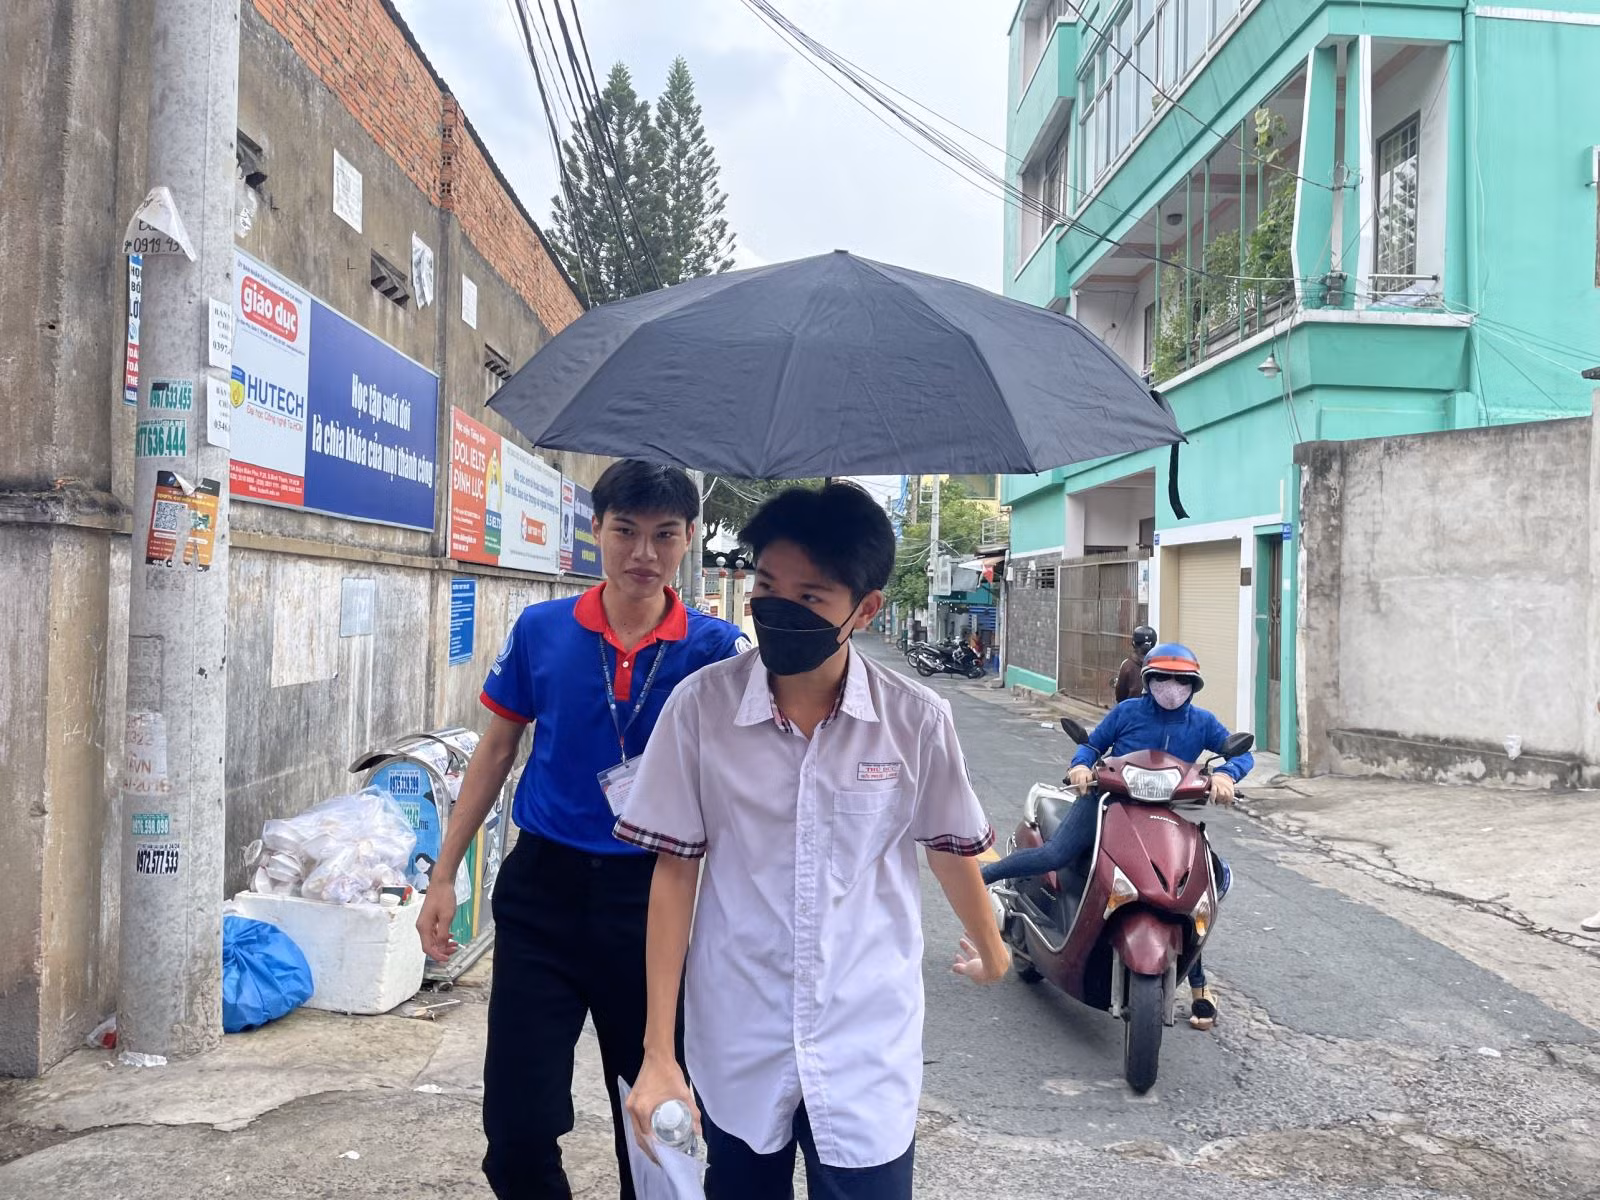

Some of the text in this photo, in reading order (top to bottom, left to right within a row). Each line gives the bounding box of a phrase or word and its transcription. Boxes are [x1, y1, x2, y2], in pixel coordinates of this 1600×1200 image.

[243, 283, 273, 319] giáo
[274, 301, 297, 335] dục
[247, 374, 304, 419] HUTECH
[351, 373, 411, 432] Học tập suốt đời
[312, 414, 433, 489] là chìa khóa của mọi thành công
[454, 440, 469, 466] DOL
[469, 446, 486, 474] IELTS
[136, 849, 179, 875] 0972.577.533
